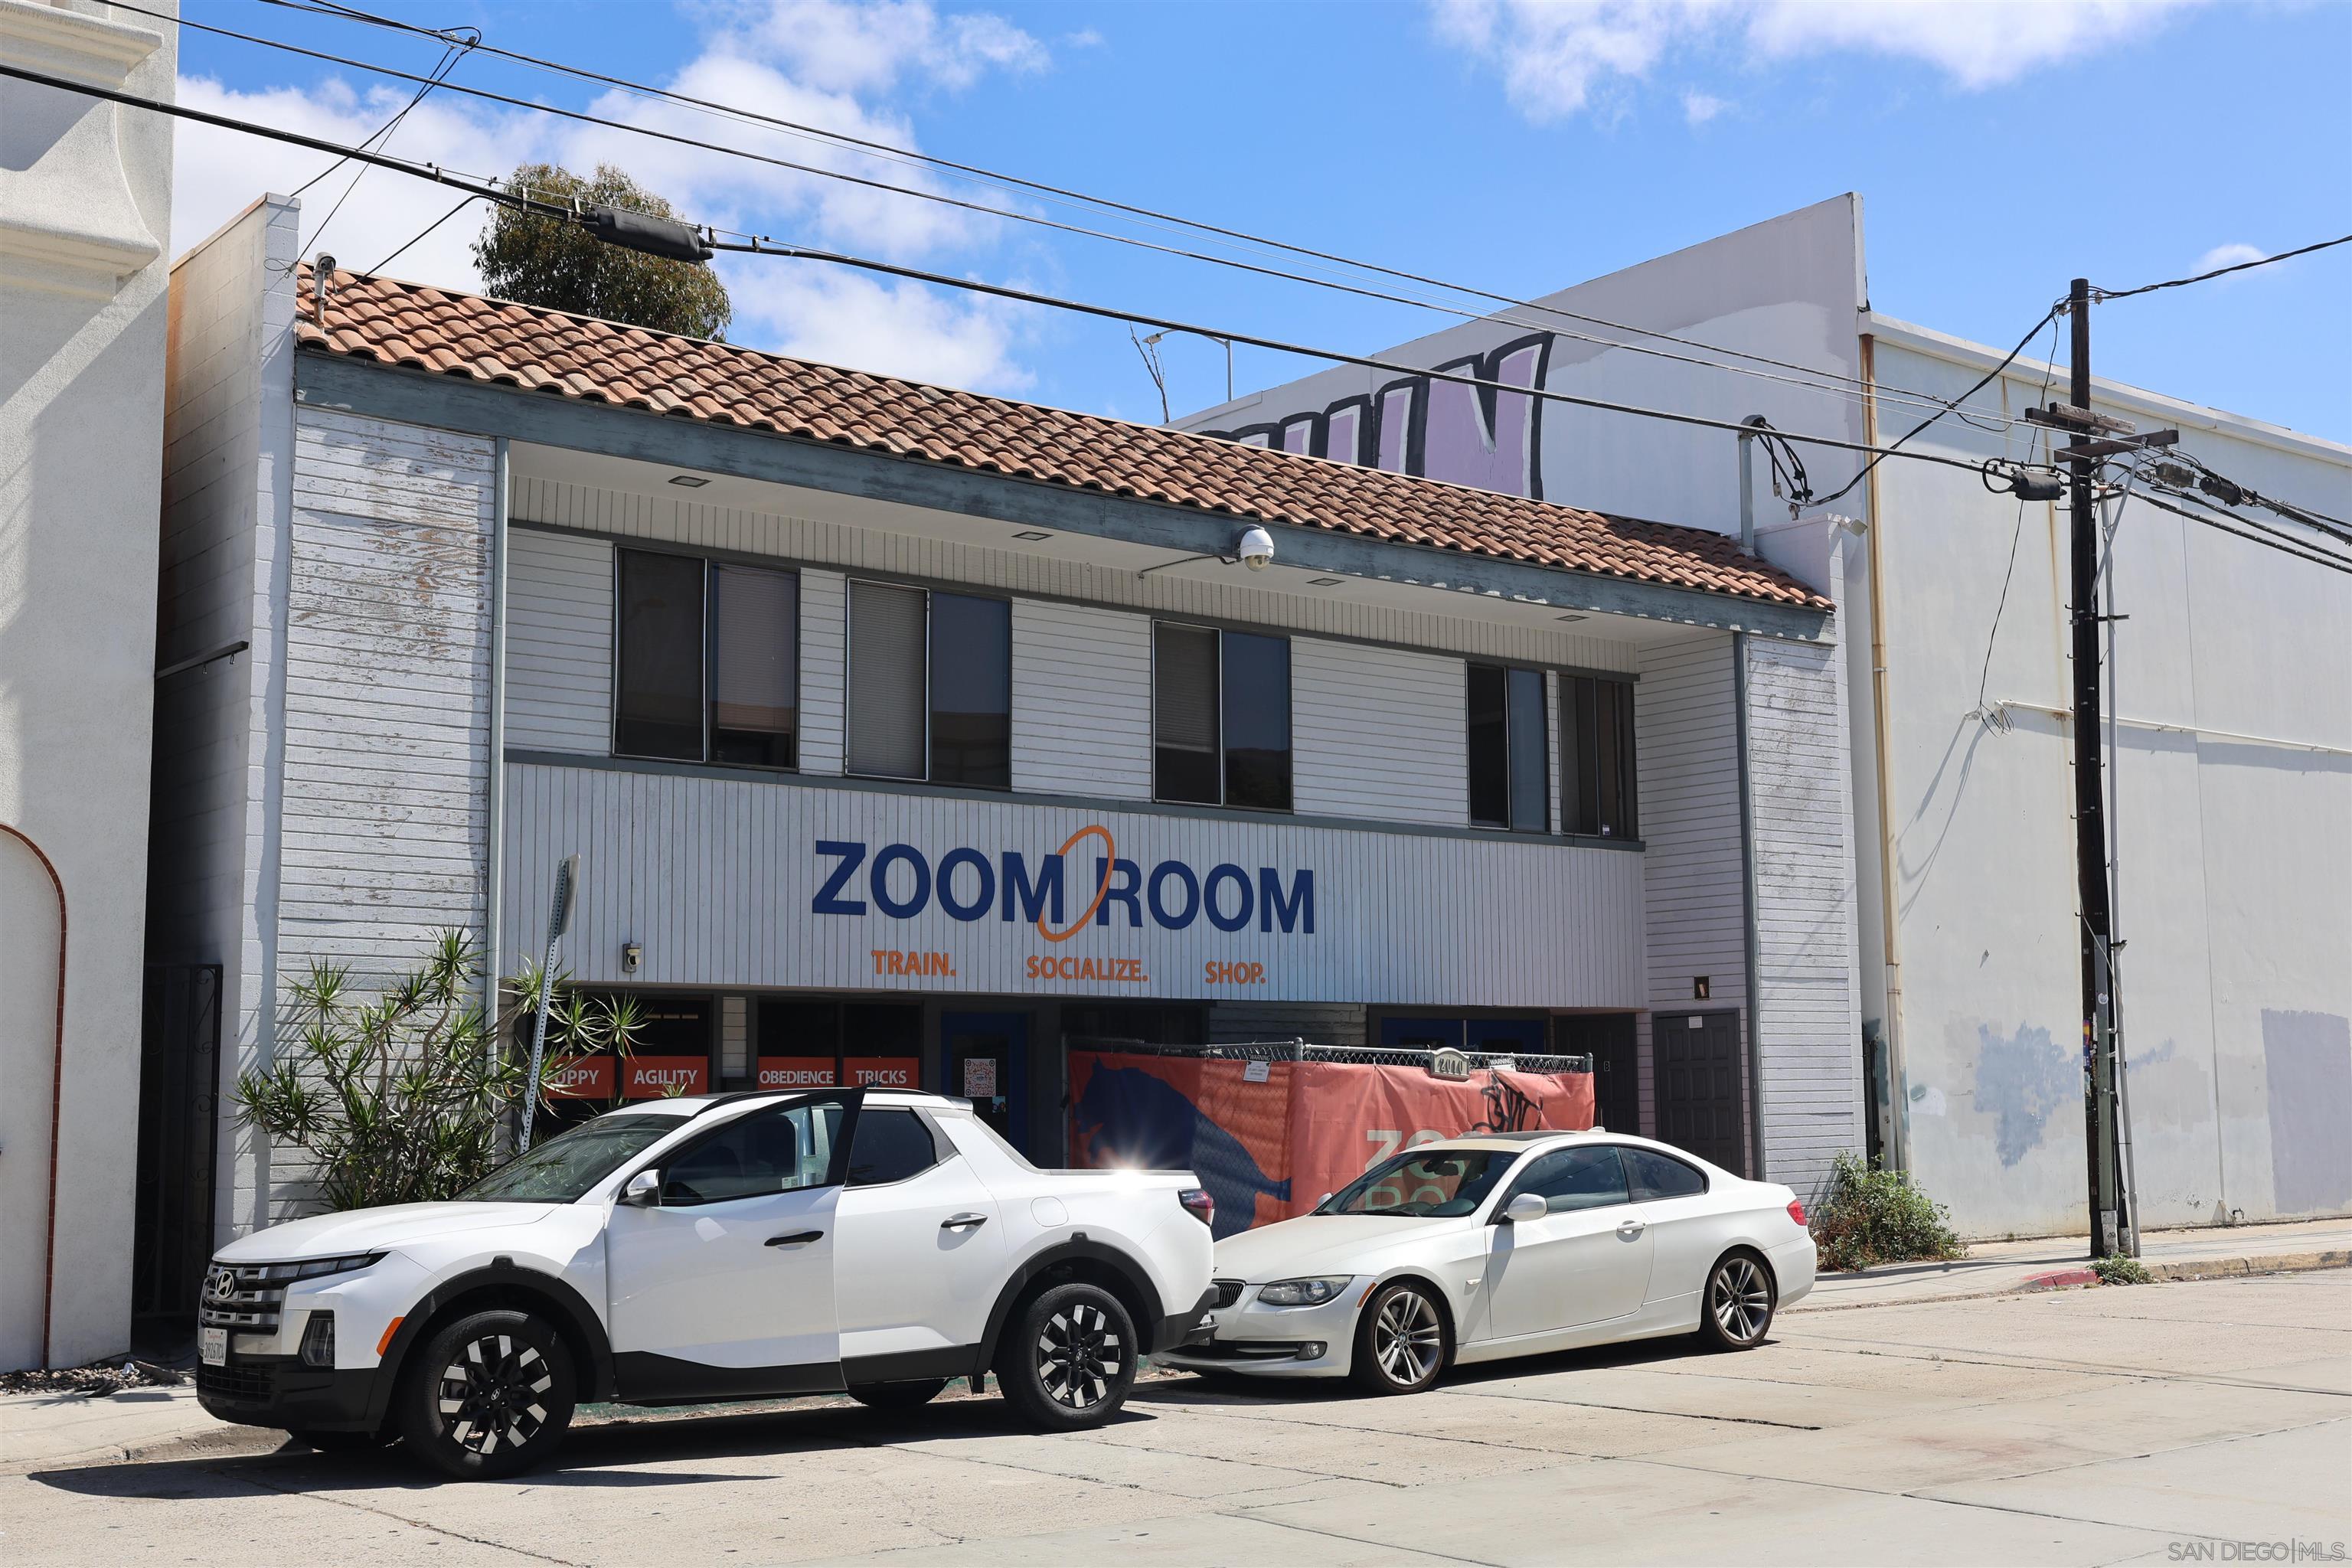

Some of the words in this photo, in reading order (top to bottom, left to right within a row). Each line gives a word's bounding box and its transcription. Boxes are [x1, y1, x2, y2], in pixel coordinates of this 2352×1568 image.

[812, 840, 1064, 923] ZOOM
[1096, 858, 1315, 934] ROOM
[871, 949, 957, 977] TRAIN.
[1027, 955, 1148, 982] SOCIALIZE.
[1205, 961, 1266, 985] SHOP.
[1248, 1054, 1271, 1062] WARNING
[1489, 1057, 1513, 1066] WARNING
[548, 1070, 599, 1085] UPPY
[633, 1070, 698, 1085] AGILITY
[759, 1070, 834, 1084] OBEDIENCE
[855, 1070, 907, 1084] TRICKS
